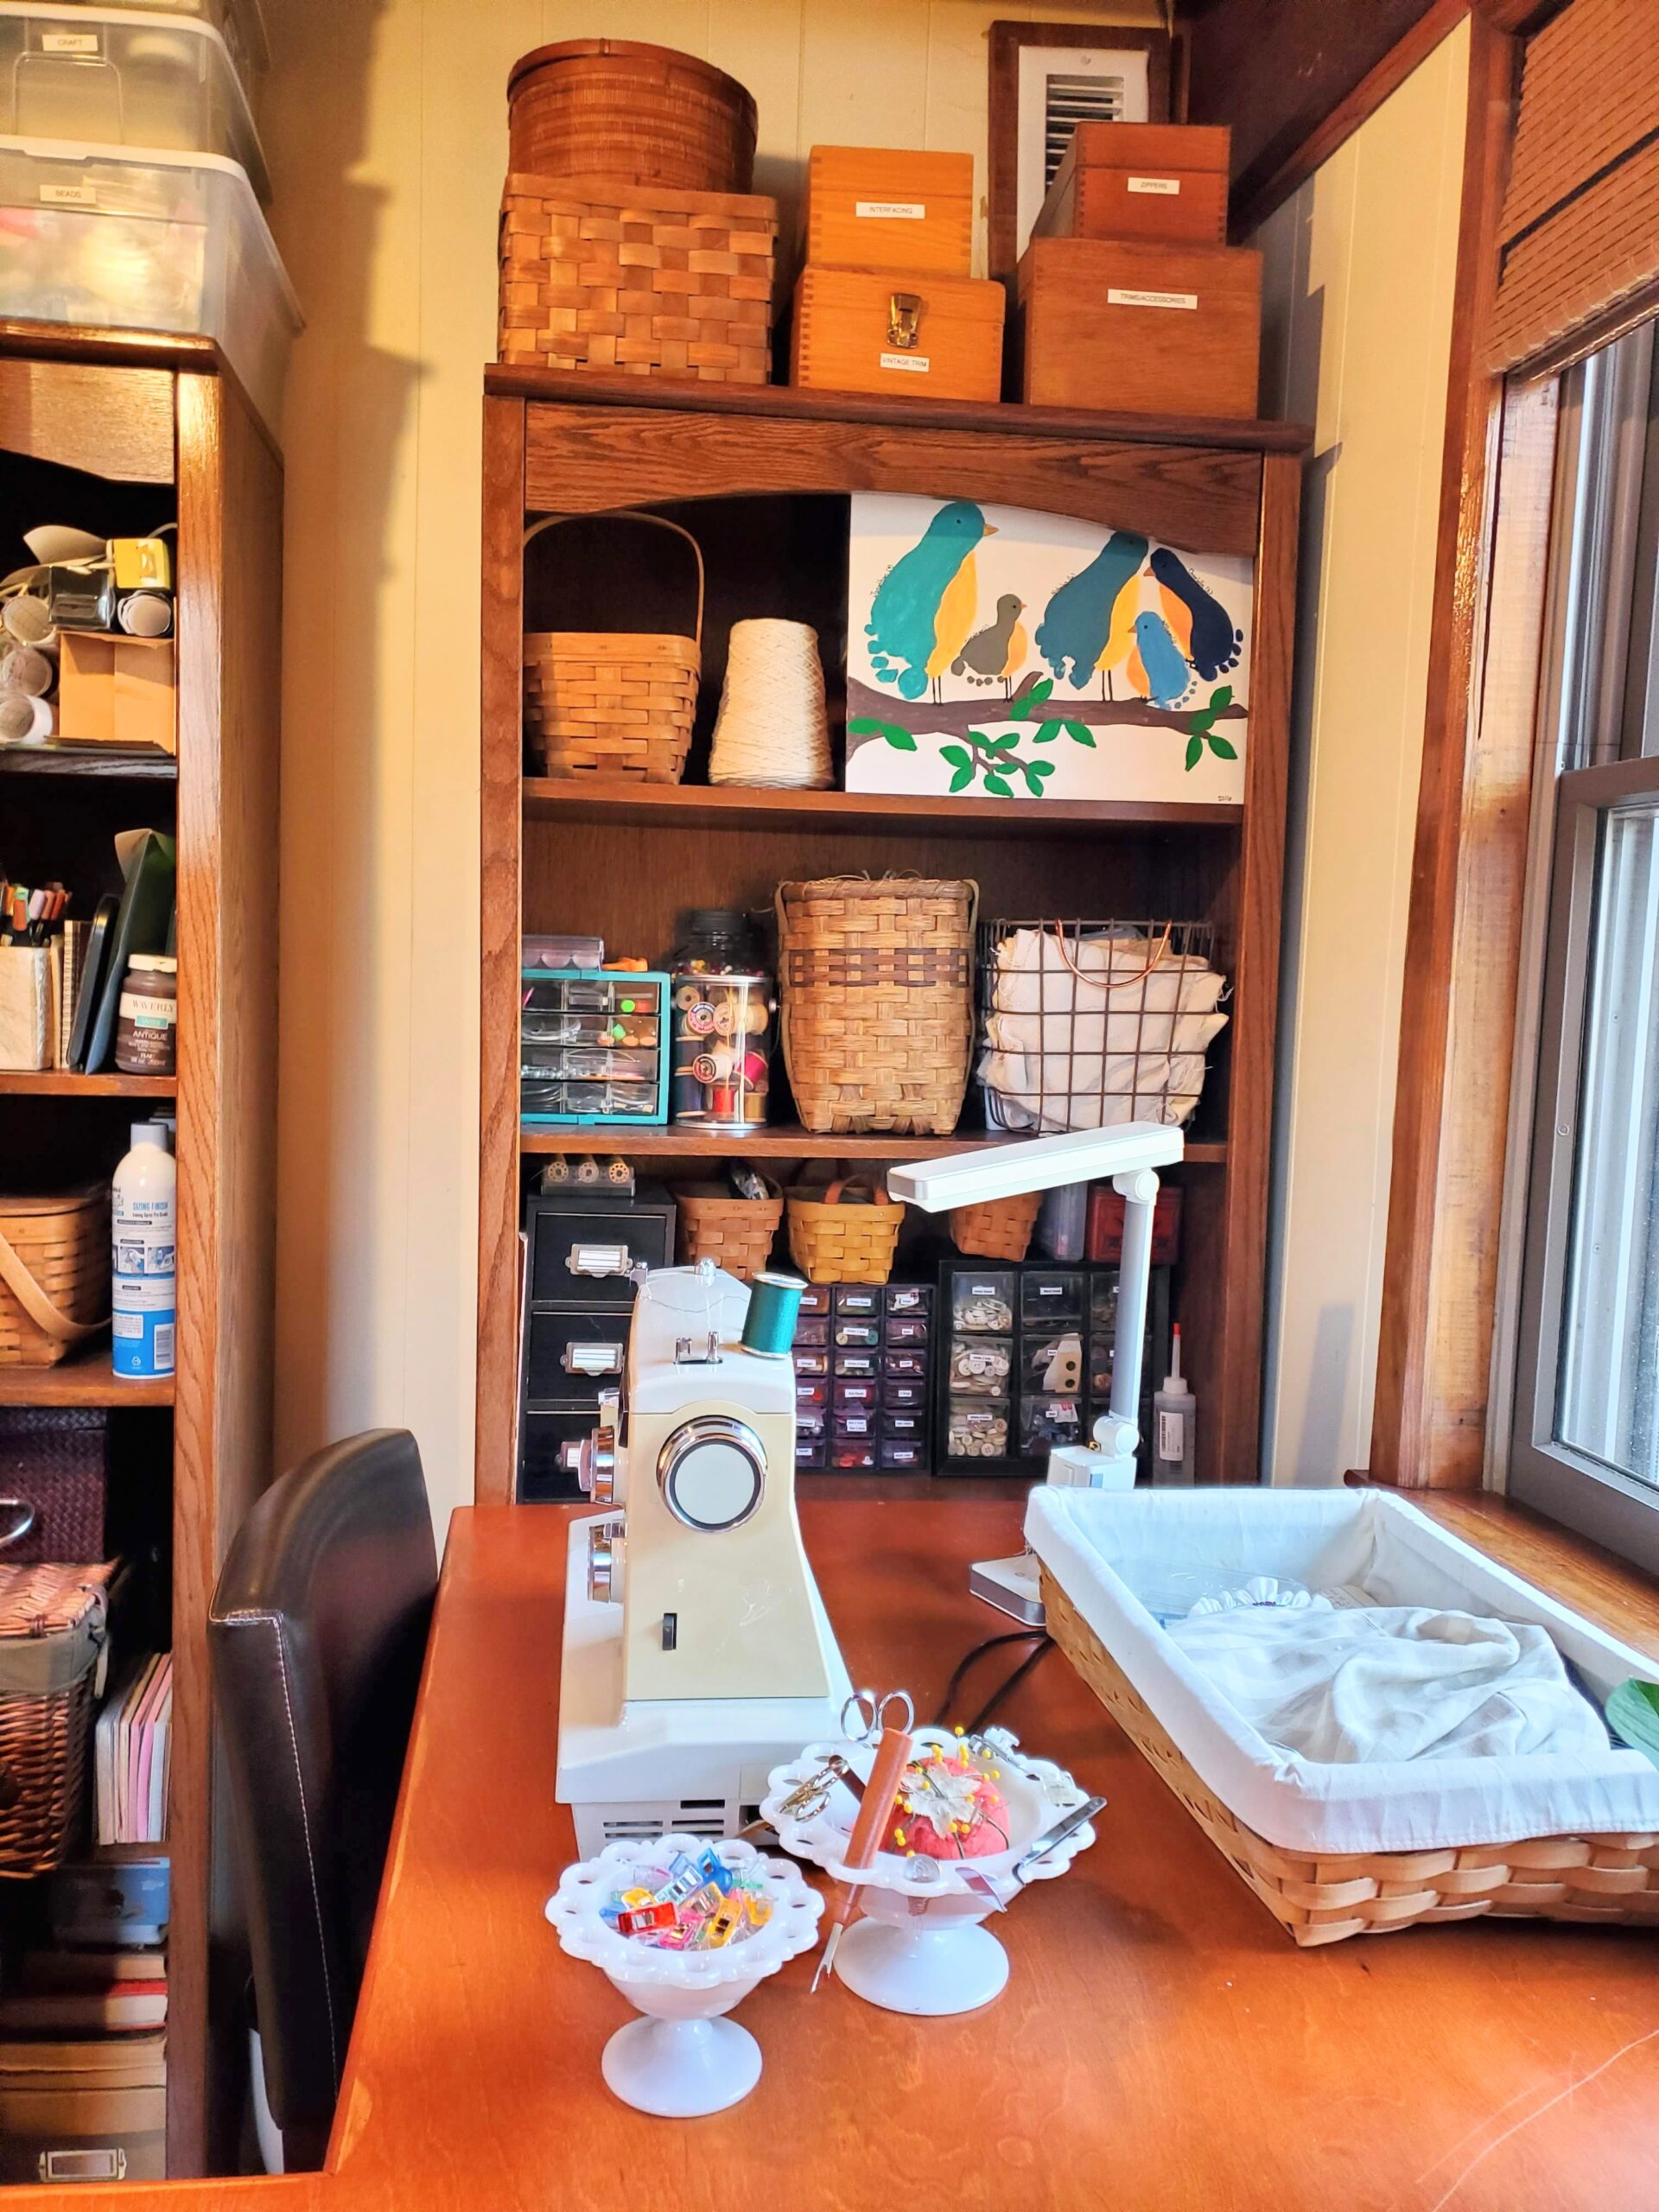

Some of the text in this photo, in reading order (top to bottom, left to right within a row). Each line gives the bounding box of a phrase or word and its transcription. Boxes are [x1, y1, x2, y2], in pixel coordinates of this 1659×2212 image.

[55, 189, 82, 199] BEADS
[868, 206, 913, 214] INTERFACING
[882, 357, 910, 365] VINTAGE
[132, 1000, 174, 1014] WAVERLY
[132, 1030, 168, 1040] ANTIQUE
